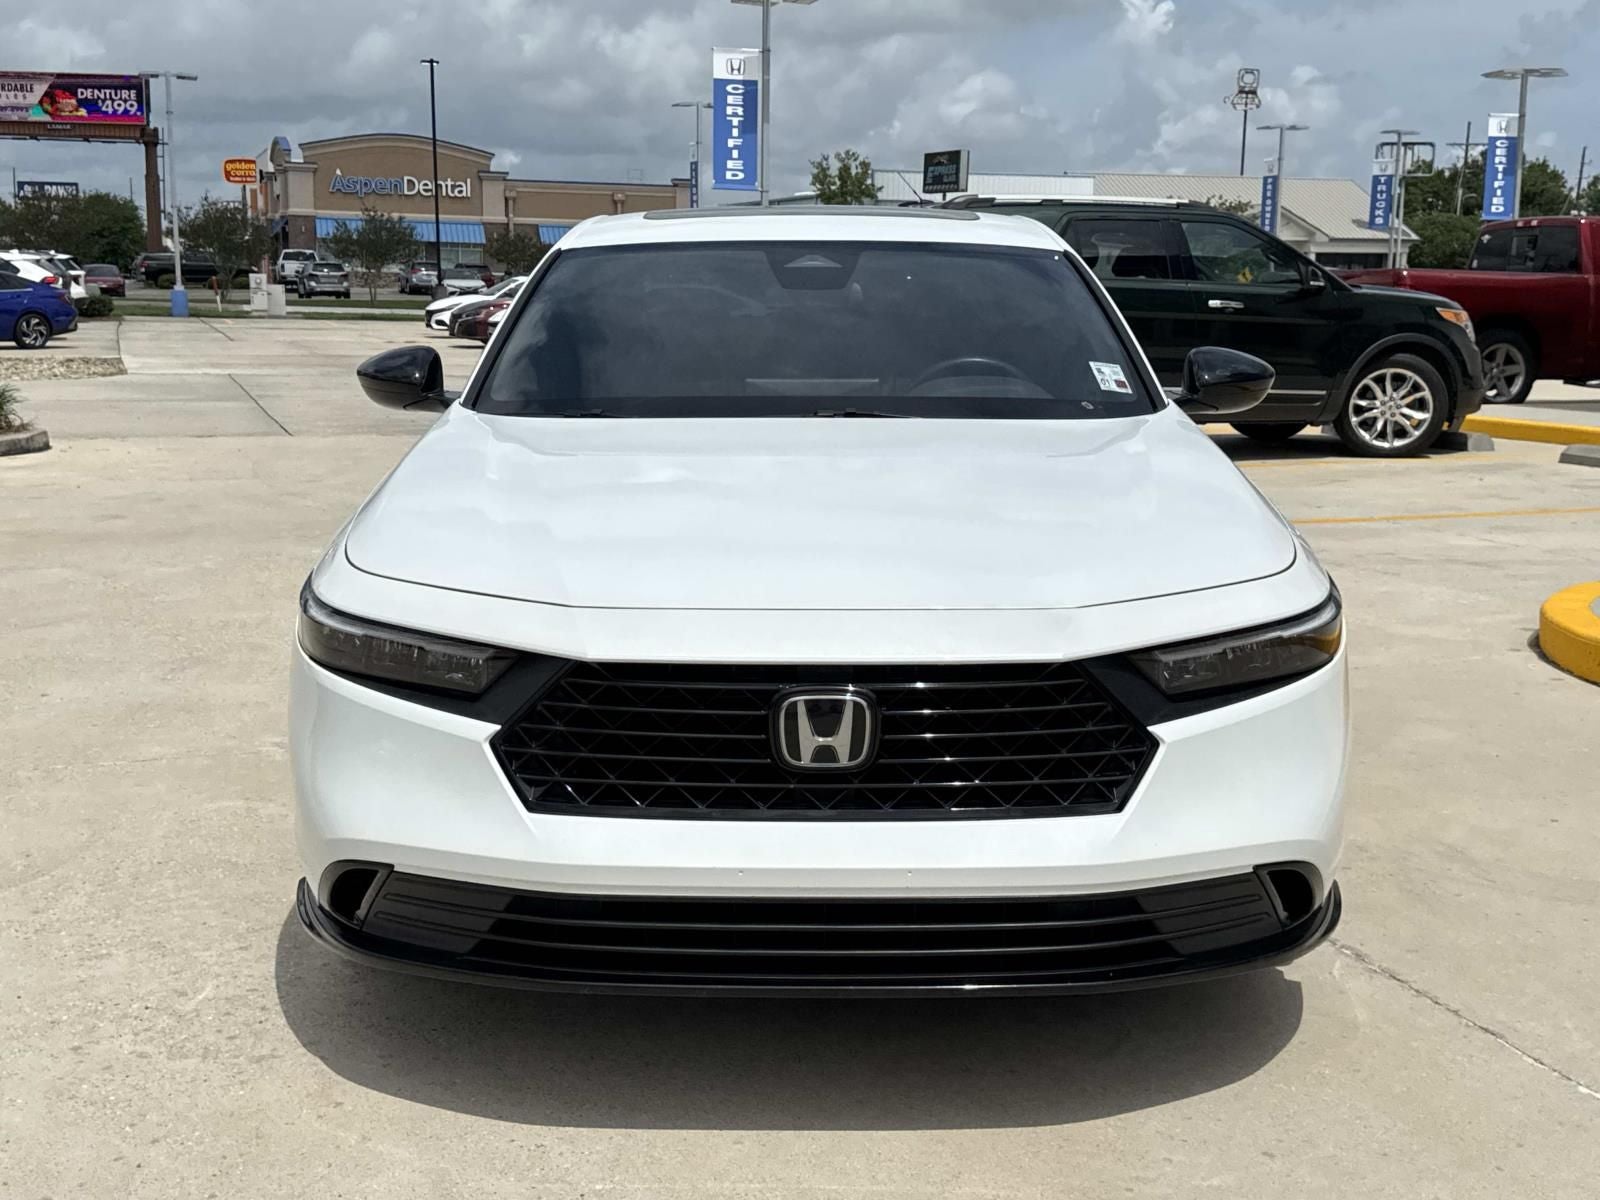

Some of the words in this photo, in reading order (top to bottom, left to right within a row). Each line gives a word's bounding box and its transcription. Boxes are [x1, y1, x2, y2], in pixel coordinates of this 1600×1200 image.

[77, 88, 137, 100] DENTURE
[725, 84, 745, 181] CERTIFIED
[225, 161, 256, 171] golden
[1491, 139, 1509, 213] CERTIFIED
[1374, 176, 1388, 225] TRUCKS
